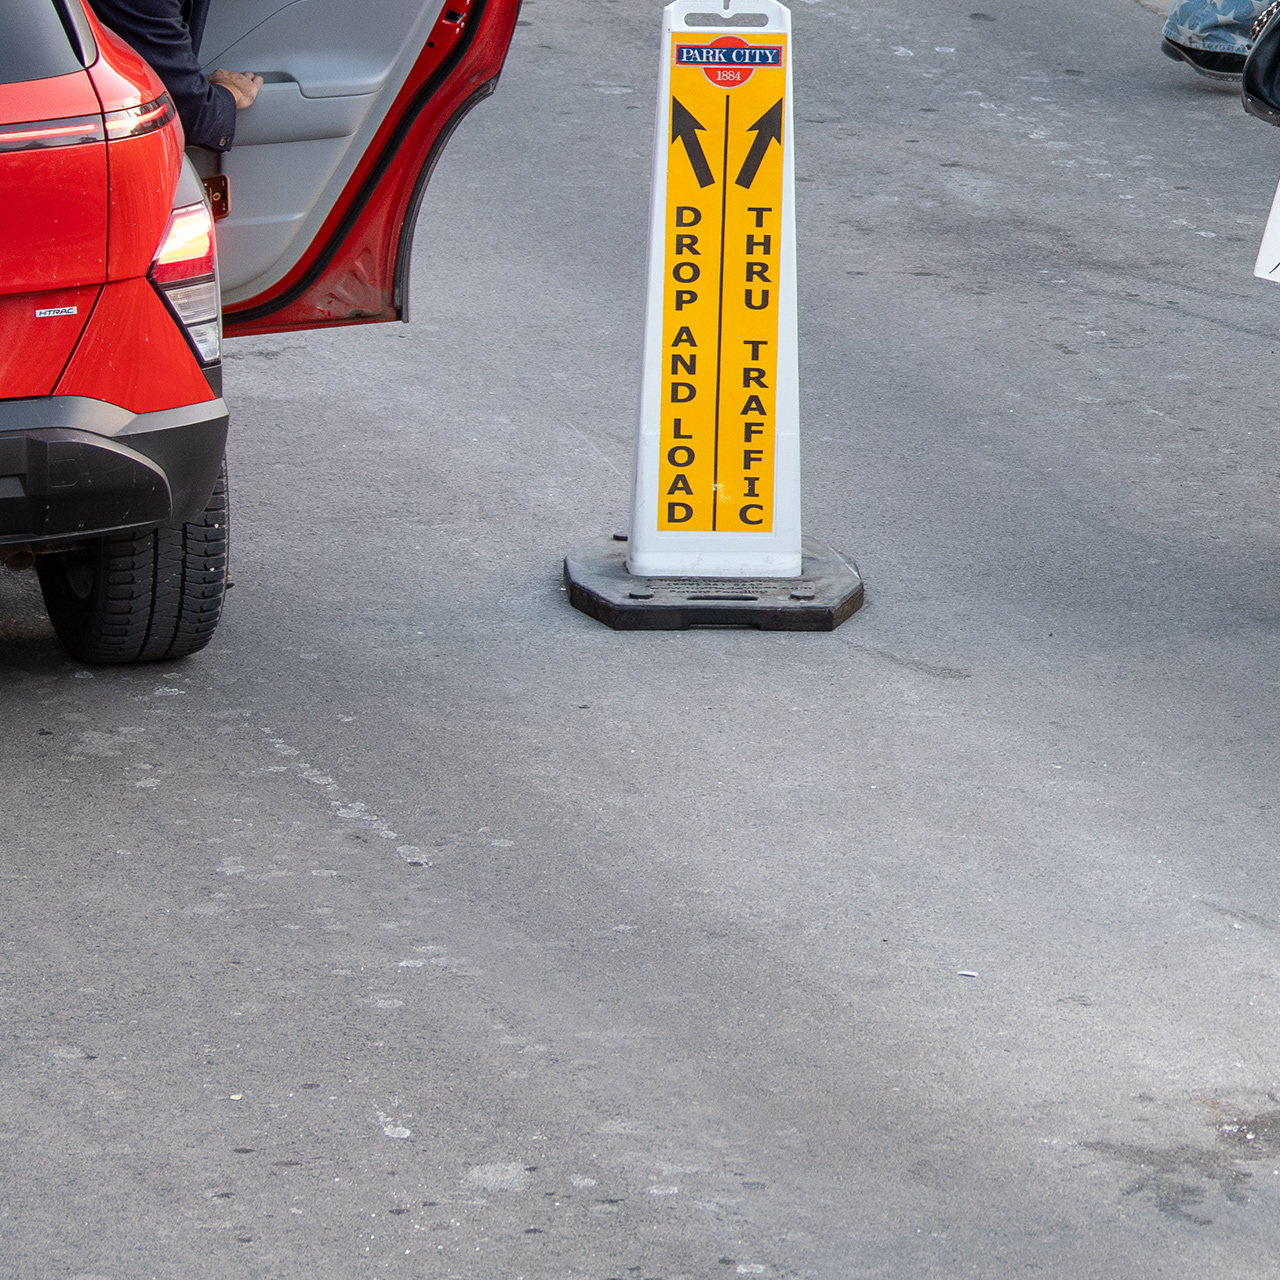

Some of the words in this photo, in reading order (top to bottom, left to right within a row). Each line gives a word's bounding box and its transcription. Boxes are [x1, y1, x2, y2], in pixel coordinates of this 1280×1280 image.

[681, 48, 727, 62] PARK
[732, 49, 777, 63] CITY
[716, 70, 741, 81] 1884
[672, 206, 702, 311] DROP
[744, 207, 772, 310] THRU
[670, 326, 698, 403] AND
[667, 418, 695, 524] LOAD
[739, 340, 769, 525] TRAFFIC
